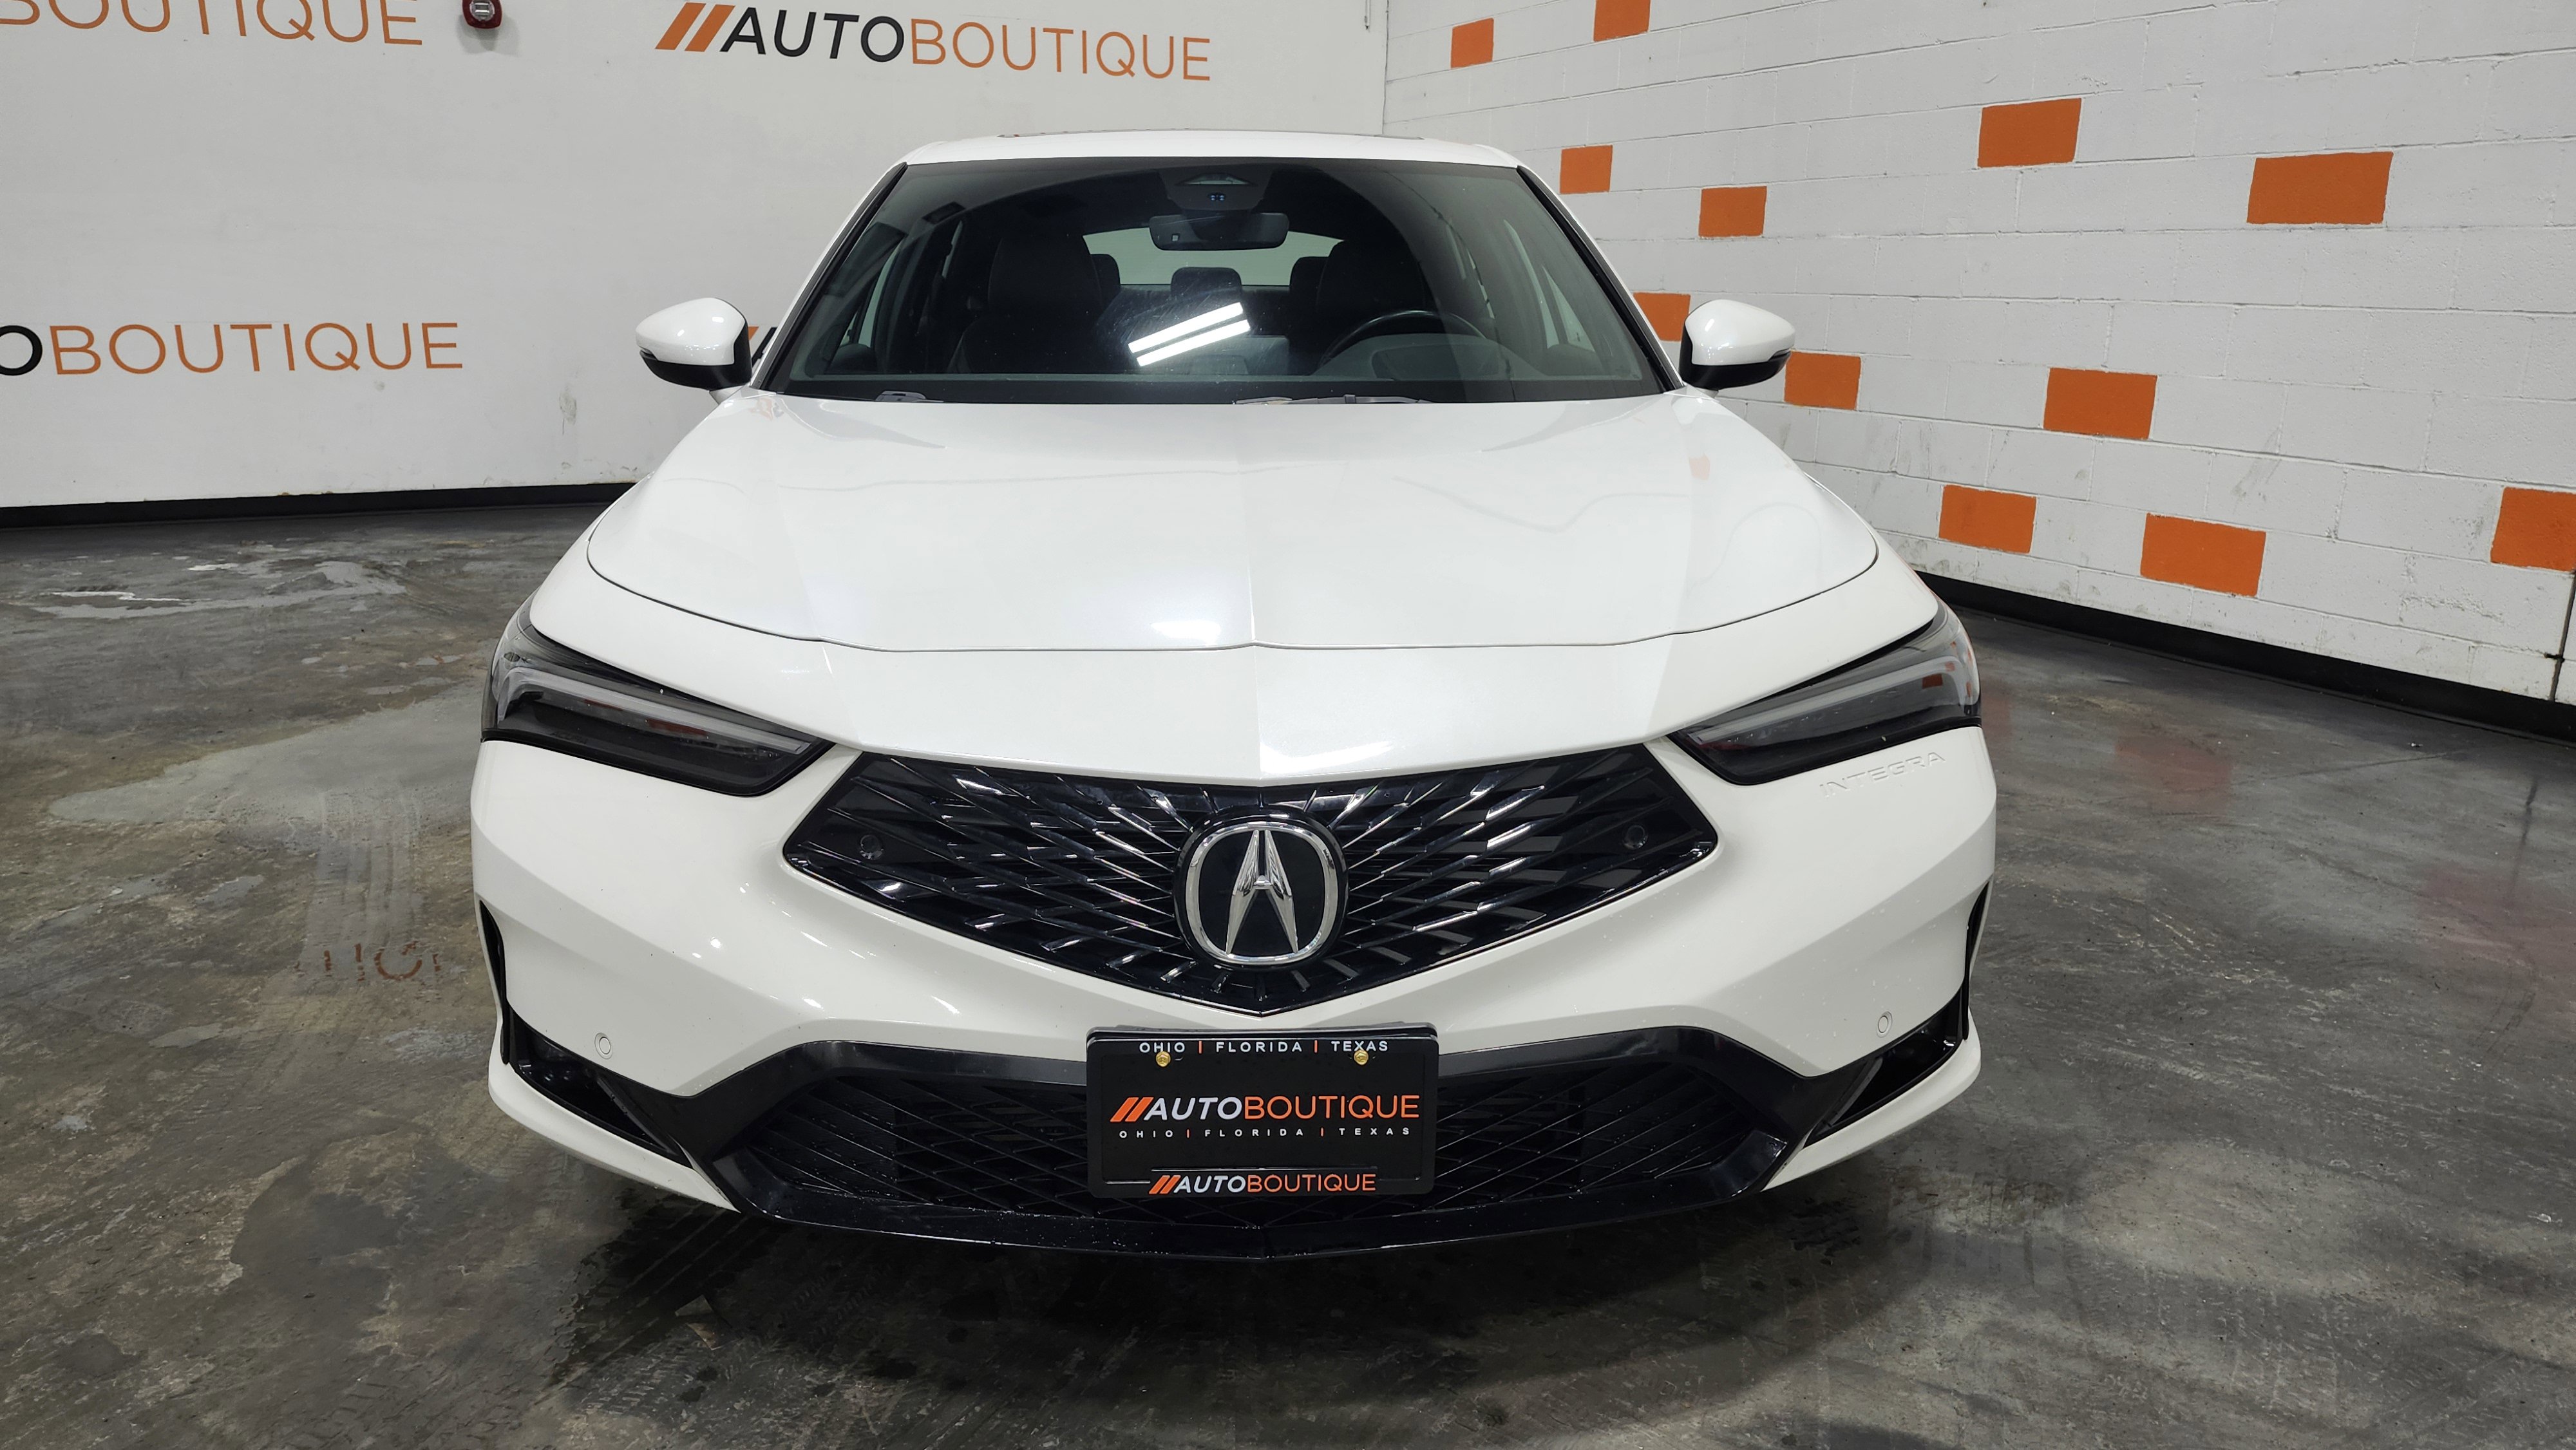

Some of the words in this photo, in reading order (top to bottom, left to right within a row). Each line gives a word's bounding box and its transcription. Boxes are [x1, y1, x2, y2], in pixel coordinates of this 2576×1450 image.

[719, 6, 1211, 82] AUTOBOUTIQUE
[1819, 751, 1946, 798] INTEGRA
[1139, 1041, 1186, 1054] OHIO
[1215, 1040, 1303, 1053] FLORIDA
[1331, 1040, 1388, 1053] TEXAS
[1142, 1095, 1421, 1121] AUTOBOUTIQUE
[1119, 1129, 1174, 1139] OHIO
[1204, 1128, 1304, 1138] FLORIDA
[1338, 1127, 1410, 1136] TEXAS
[1173, 1173, 1376, 1194] AUTOBOUTIQUE
